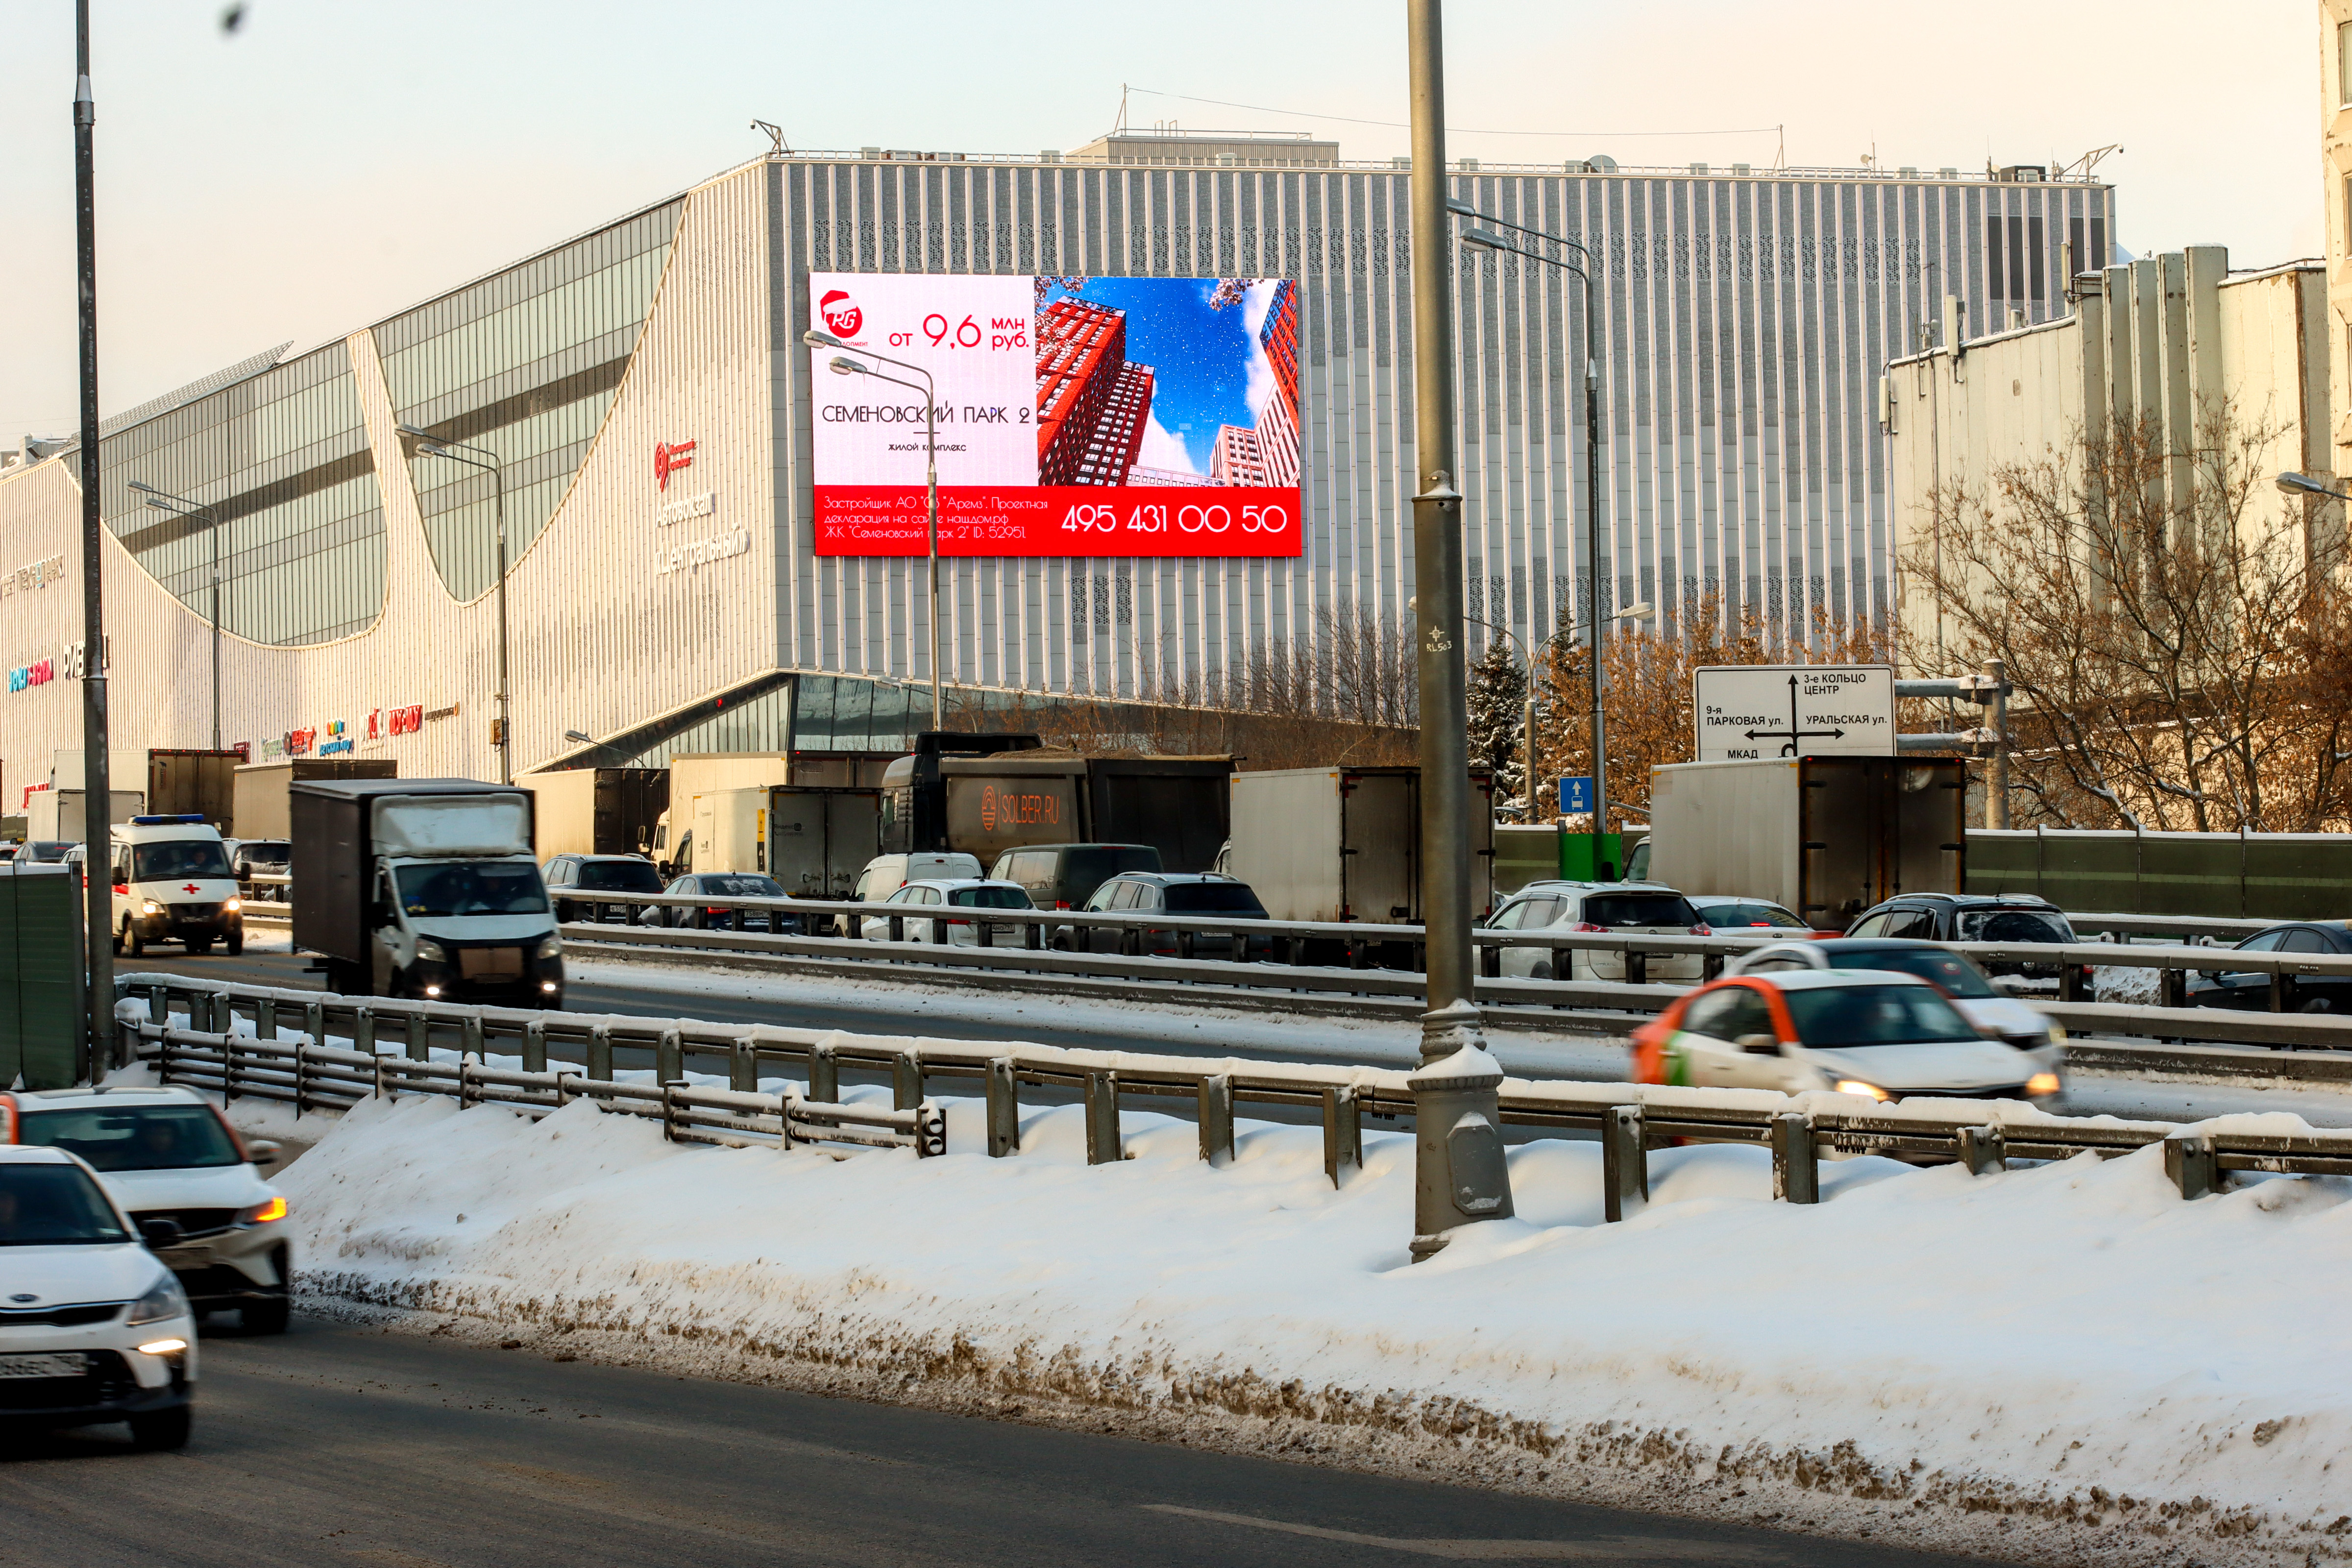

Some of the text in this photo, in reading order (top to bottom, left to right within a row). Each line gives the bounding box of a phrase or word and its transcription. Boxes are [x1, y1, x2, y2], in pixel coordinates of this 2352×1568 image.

[992, 318, 1025, 330] млн
[889, 314, 982, 349] от 9,6
[992, 331, 1029, 351] руб.
[822, 400, 1030, 424] СЕМЕНОВСКИЙ ПАРК 2
[888, 443, 919, 451] жилой
[656, 492, 713, 528] Автовокзал
[823, 496, 892, 511] Застройщик
[895, 496, 917, 509] АО
[991, 496, 1048, 511] Проектная
[824, 515, 889, 526] декларация
[911, 513, 943, 524] сайе
[1061, 504, 1288, 533] 495 431 00 50
[825, 526, 845, 538] ЖК
[849, 525, 923, 538] "Семеновский
[1804, 674, 1866, 684] 3-е КОЛЬЦО
[1804, 686, 1839, 696] ЦЕНТР
[1706, 706, 1721, 714] 9-я
[1707, 716, 1784, 727] ПАРКОВАЯ ул.
[1806, 715, 1887, 726] УРАЛЬСКАЯ ул.
[1728, 750, 1758, 760] МКАД
[1001, 794, 1059, 825] SOLBER.RU
